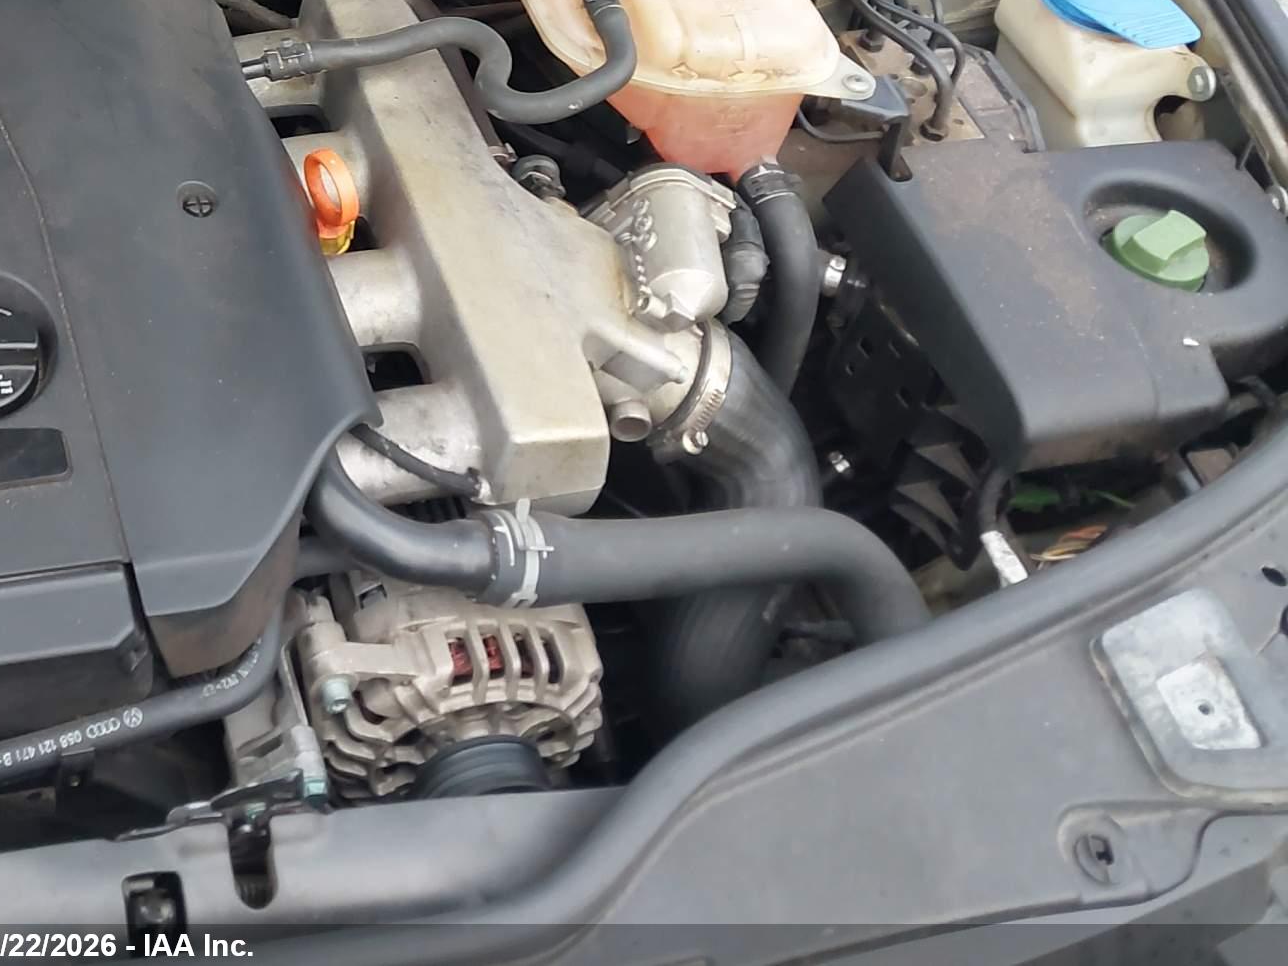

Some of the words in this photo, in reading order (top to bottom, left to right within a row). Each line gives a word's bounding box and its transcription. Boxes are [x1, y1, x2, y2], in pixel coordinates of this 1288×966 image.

[38, 738, 58, 756] 121
[59, 732, 83, 749] 058
[15, 745, 36, 762] 471
